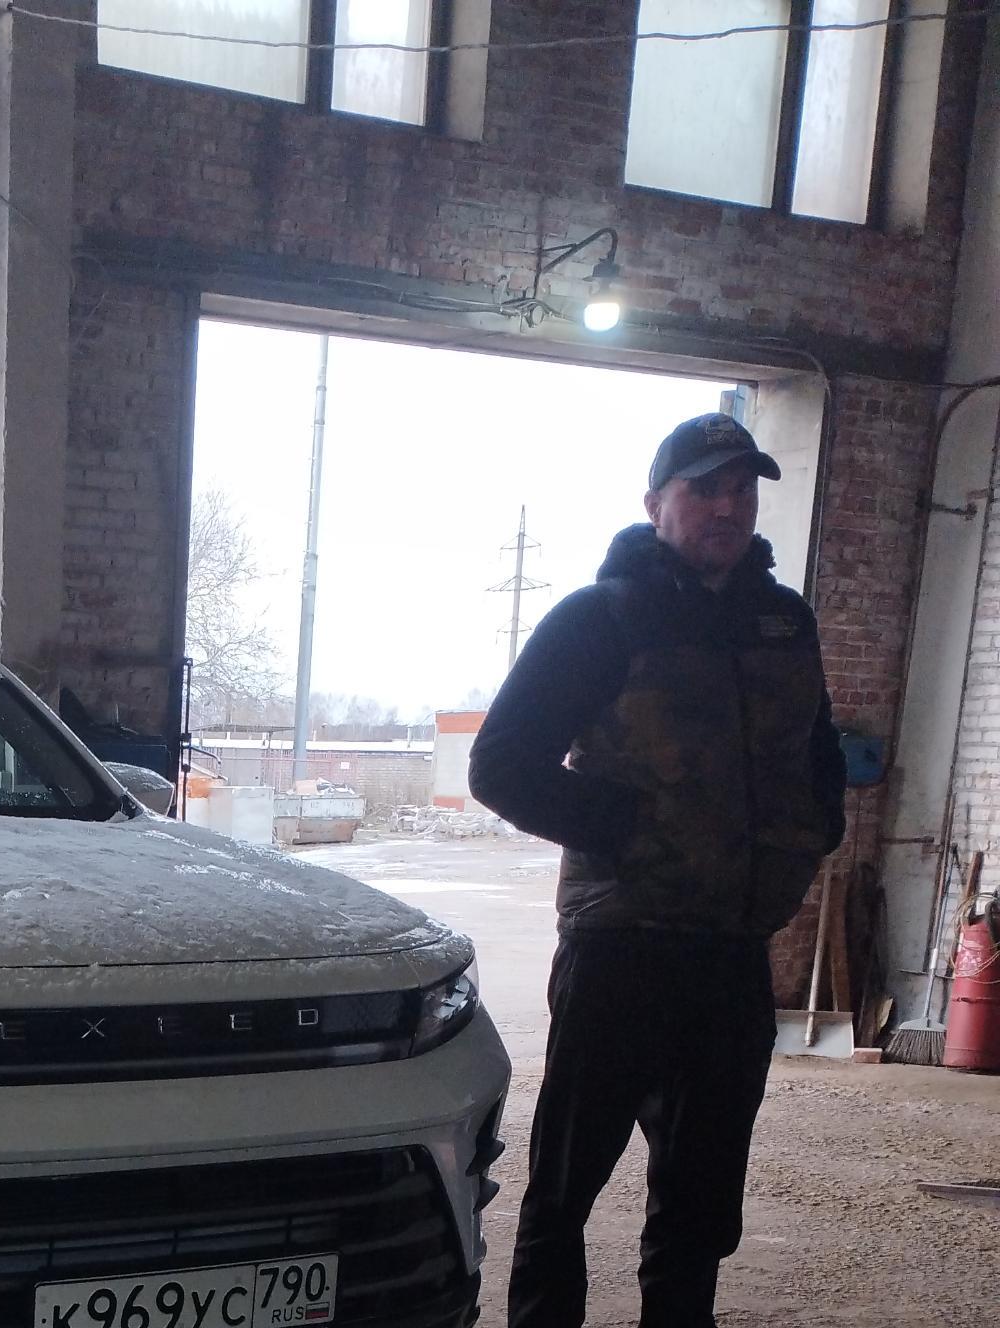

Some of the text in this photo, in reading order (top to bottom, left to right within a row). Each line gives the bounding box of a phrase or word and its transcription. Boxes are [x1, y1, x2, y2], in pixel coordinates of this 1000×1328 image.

[0, 1008, 319, 1040] EXEED
[259, 1262, 327, 1309] 790
[271, 1306, 304, 1324] RUS
